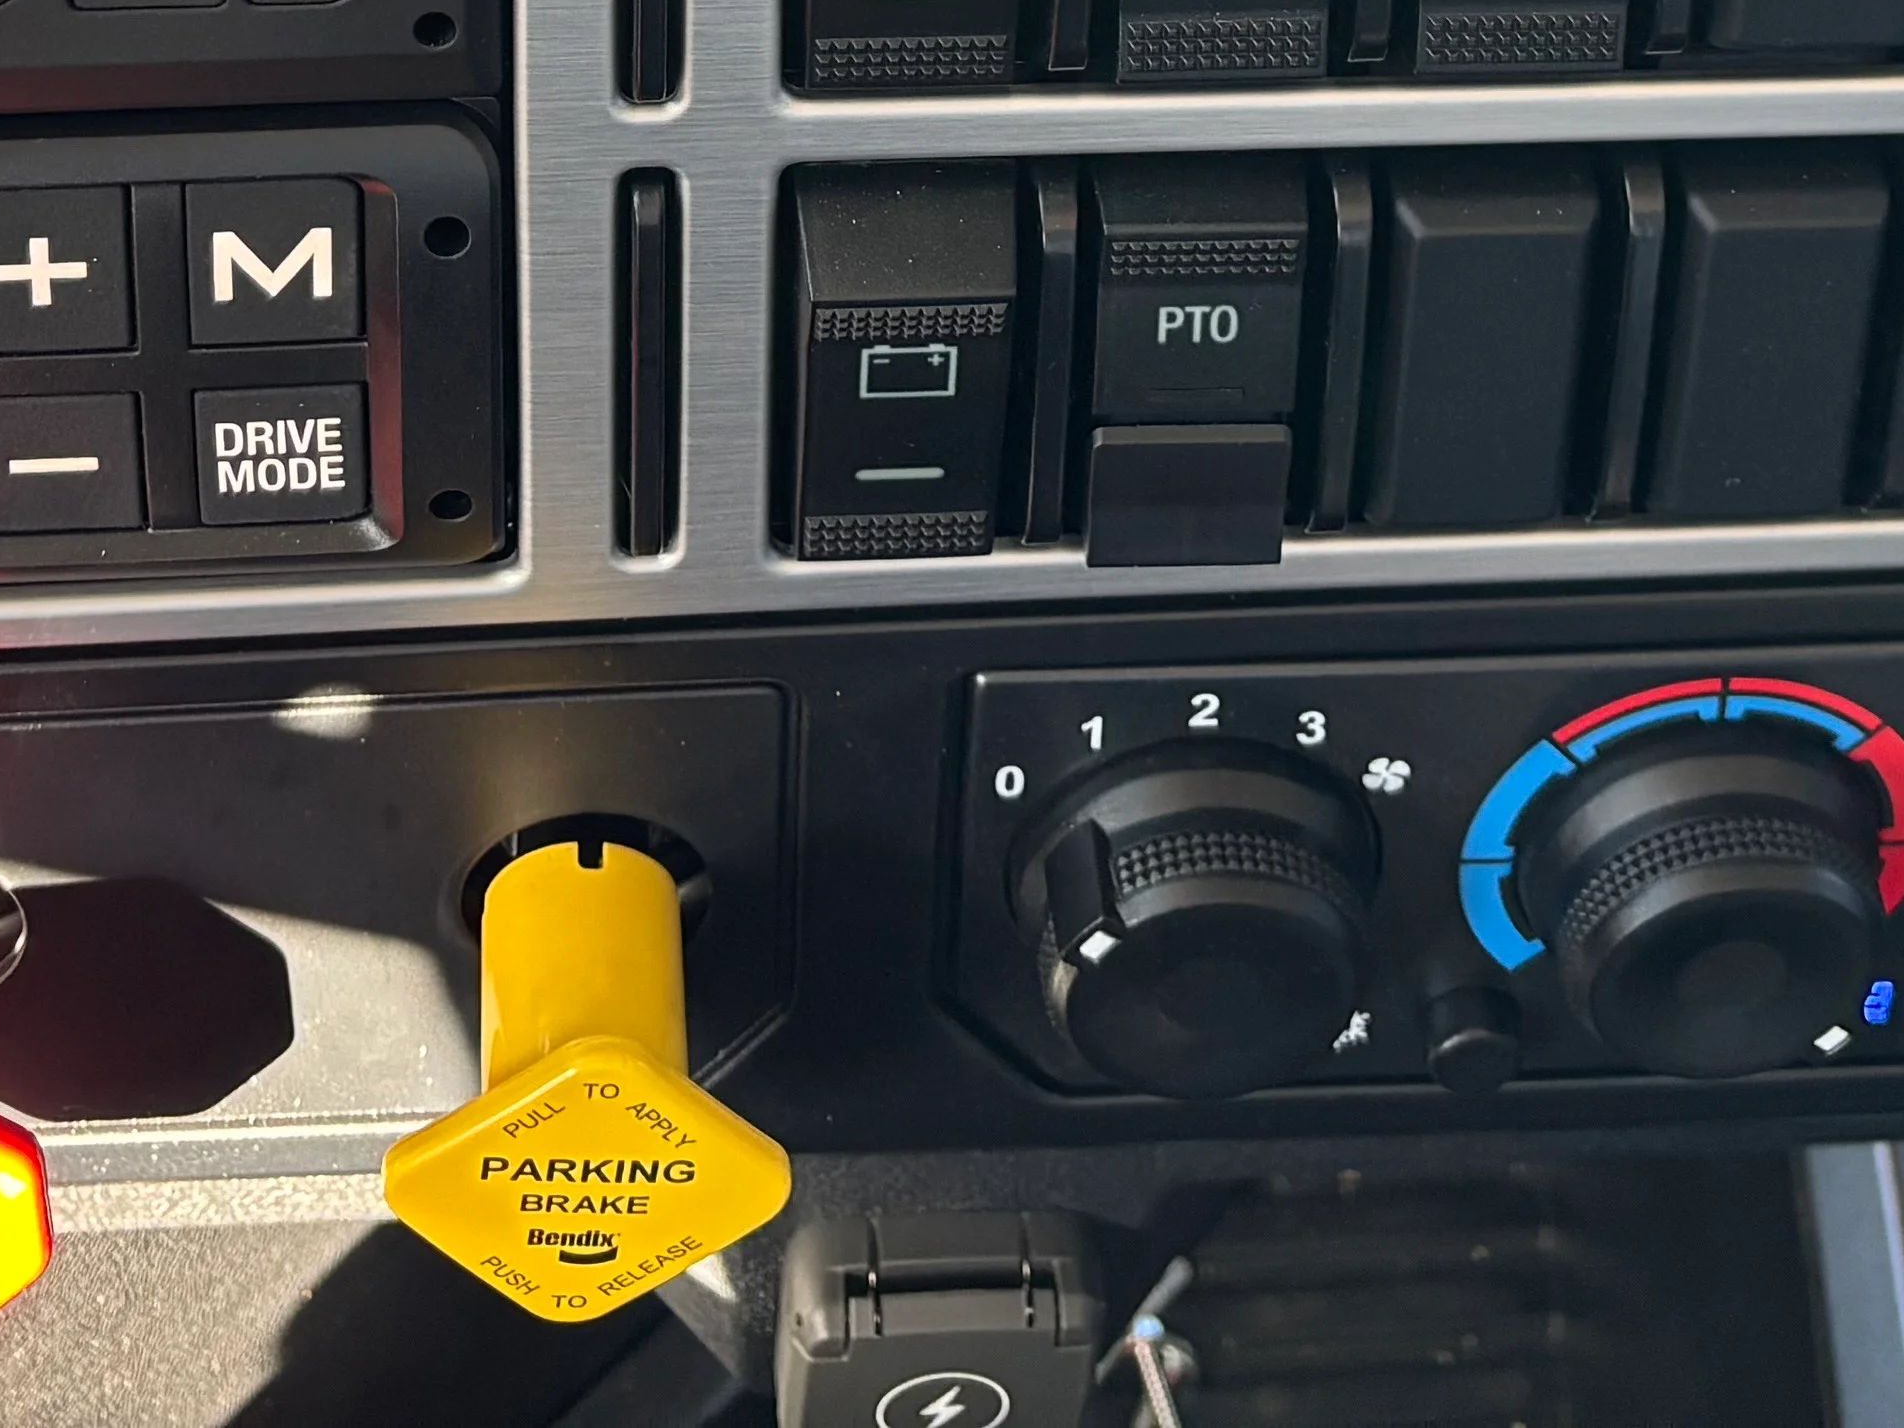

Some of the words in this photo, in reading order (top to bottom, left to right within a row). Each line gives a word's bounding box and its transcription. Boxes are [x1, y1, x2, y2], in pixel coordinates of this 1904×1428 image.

[212, 227, 333, 303] M
[1157, 305, 1238, 344] PTO
[214, 417, 344, 455] DRIVE
[216, 455, 346, 494] MODE
[995, 765, 1025, 798] 0
[1081, 715, 1103, 750] 1
[1188, 693, 1220, 728] 2
[1296, 710, 1326, 745] 3
[502, 1102, 566, 1139] PULL
[583, 1083, 620, 1100] TO
[625, 1102, 696, 1149] APPLY
[480, 1157, 695, 1184] PARKING
[520, 1194, 650, 1214] BRAKE
[527, 1228, 614, 1247] Bendix
[480, 1255, 540, 1296] PUSH
[551, 1294, 588, 1309] TO
[596, 1235, 704, 1296] RELEASE
